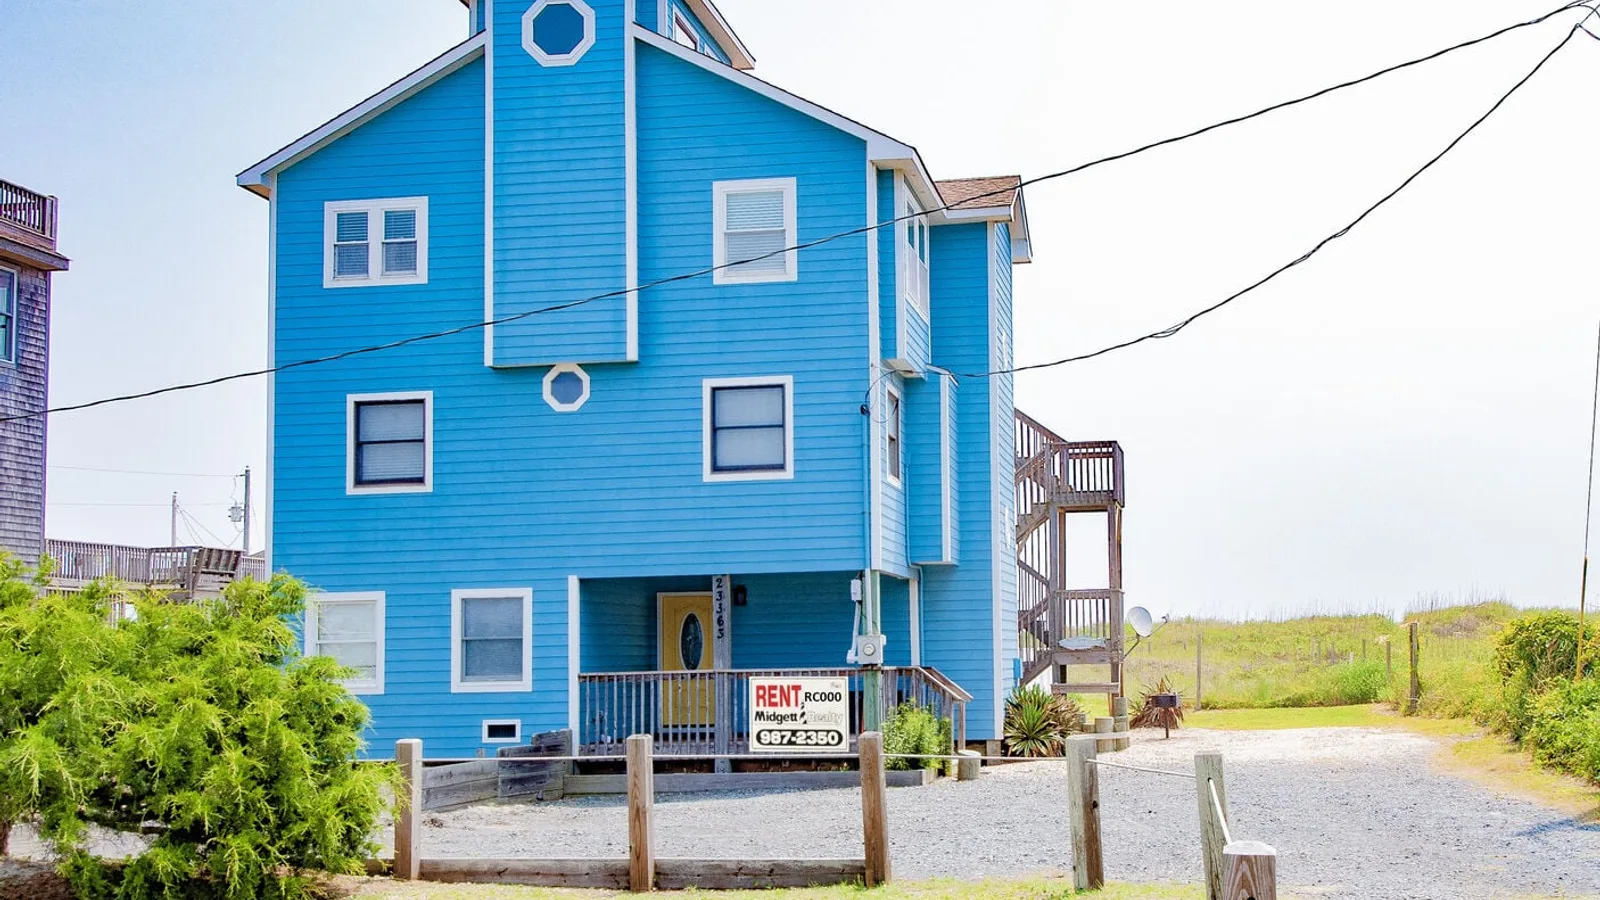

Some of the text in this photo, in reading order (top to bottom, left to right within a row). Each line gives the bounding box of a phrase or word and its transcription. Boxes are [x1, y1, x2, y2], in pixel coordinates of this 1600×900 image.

[755, 685, 802, 708] RENT
[755, 711, 798, 725] Midgett
[759, 731, 839, 745] 987-2350
